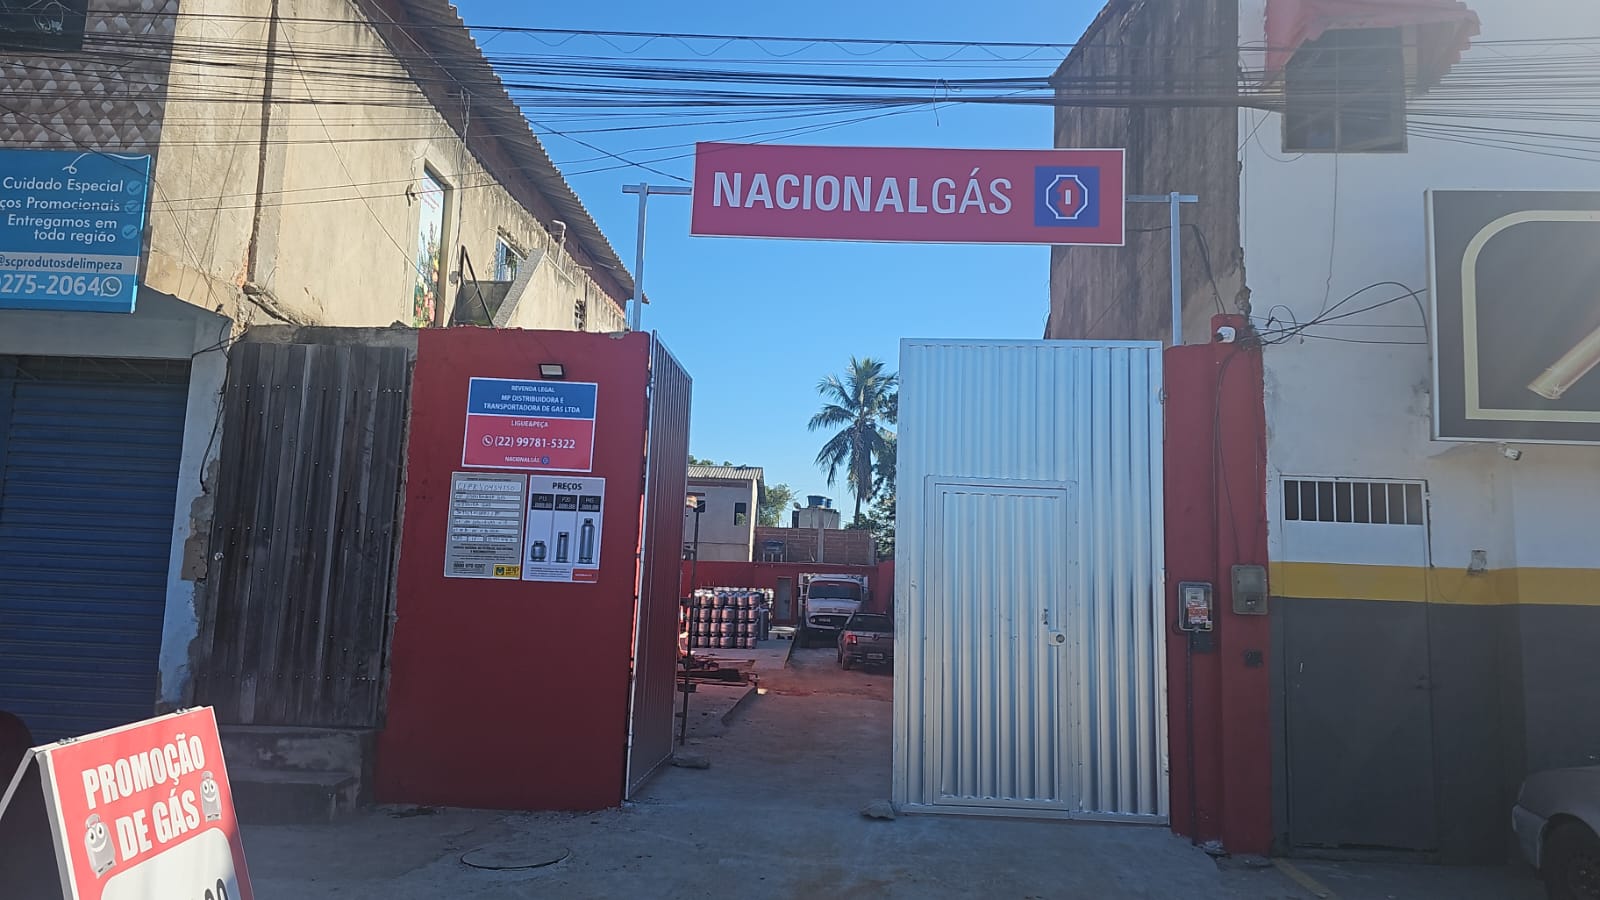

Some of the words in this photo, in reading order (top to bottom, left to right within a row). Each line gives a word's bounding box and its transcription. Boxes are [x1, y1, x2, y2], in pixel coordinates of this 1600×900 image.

[3, 176, 62, 191] Cuidado
[67, 178, 124, 194] Especial
[712, 167, 1013, 215] NACIONALGÁS
[26, 196, 120, 212] Promocionais
[8, 214, 91, 230] Entregamos
[95, 219, 117, 229] em
[34, 229, 65, 241] toda
[70, 231, 116, 245] região
[0, 274, 100, 296] 275-2064
[511, 385, 537, 393] REVENDA
[483, 402, 541, 411] TRANSPORTADORA
[512, 395, 559, 404] DISTRIBUIDORA
[494, 437, 514, 448] (22)
[516, 437, 576, 449] 99781-5322
[552, 482, 583, 491] PREÇOS
[82, 732, 206, 810] PROMOÇÃO
[115, 808, 153, 862] DE
[152, 788, 200, 844] GÁS
